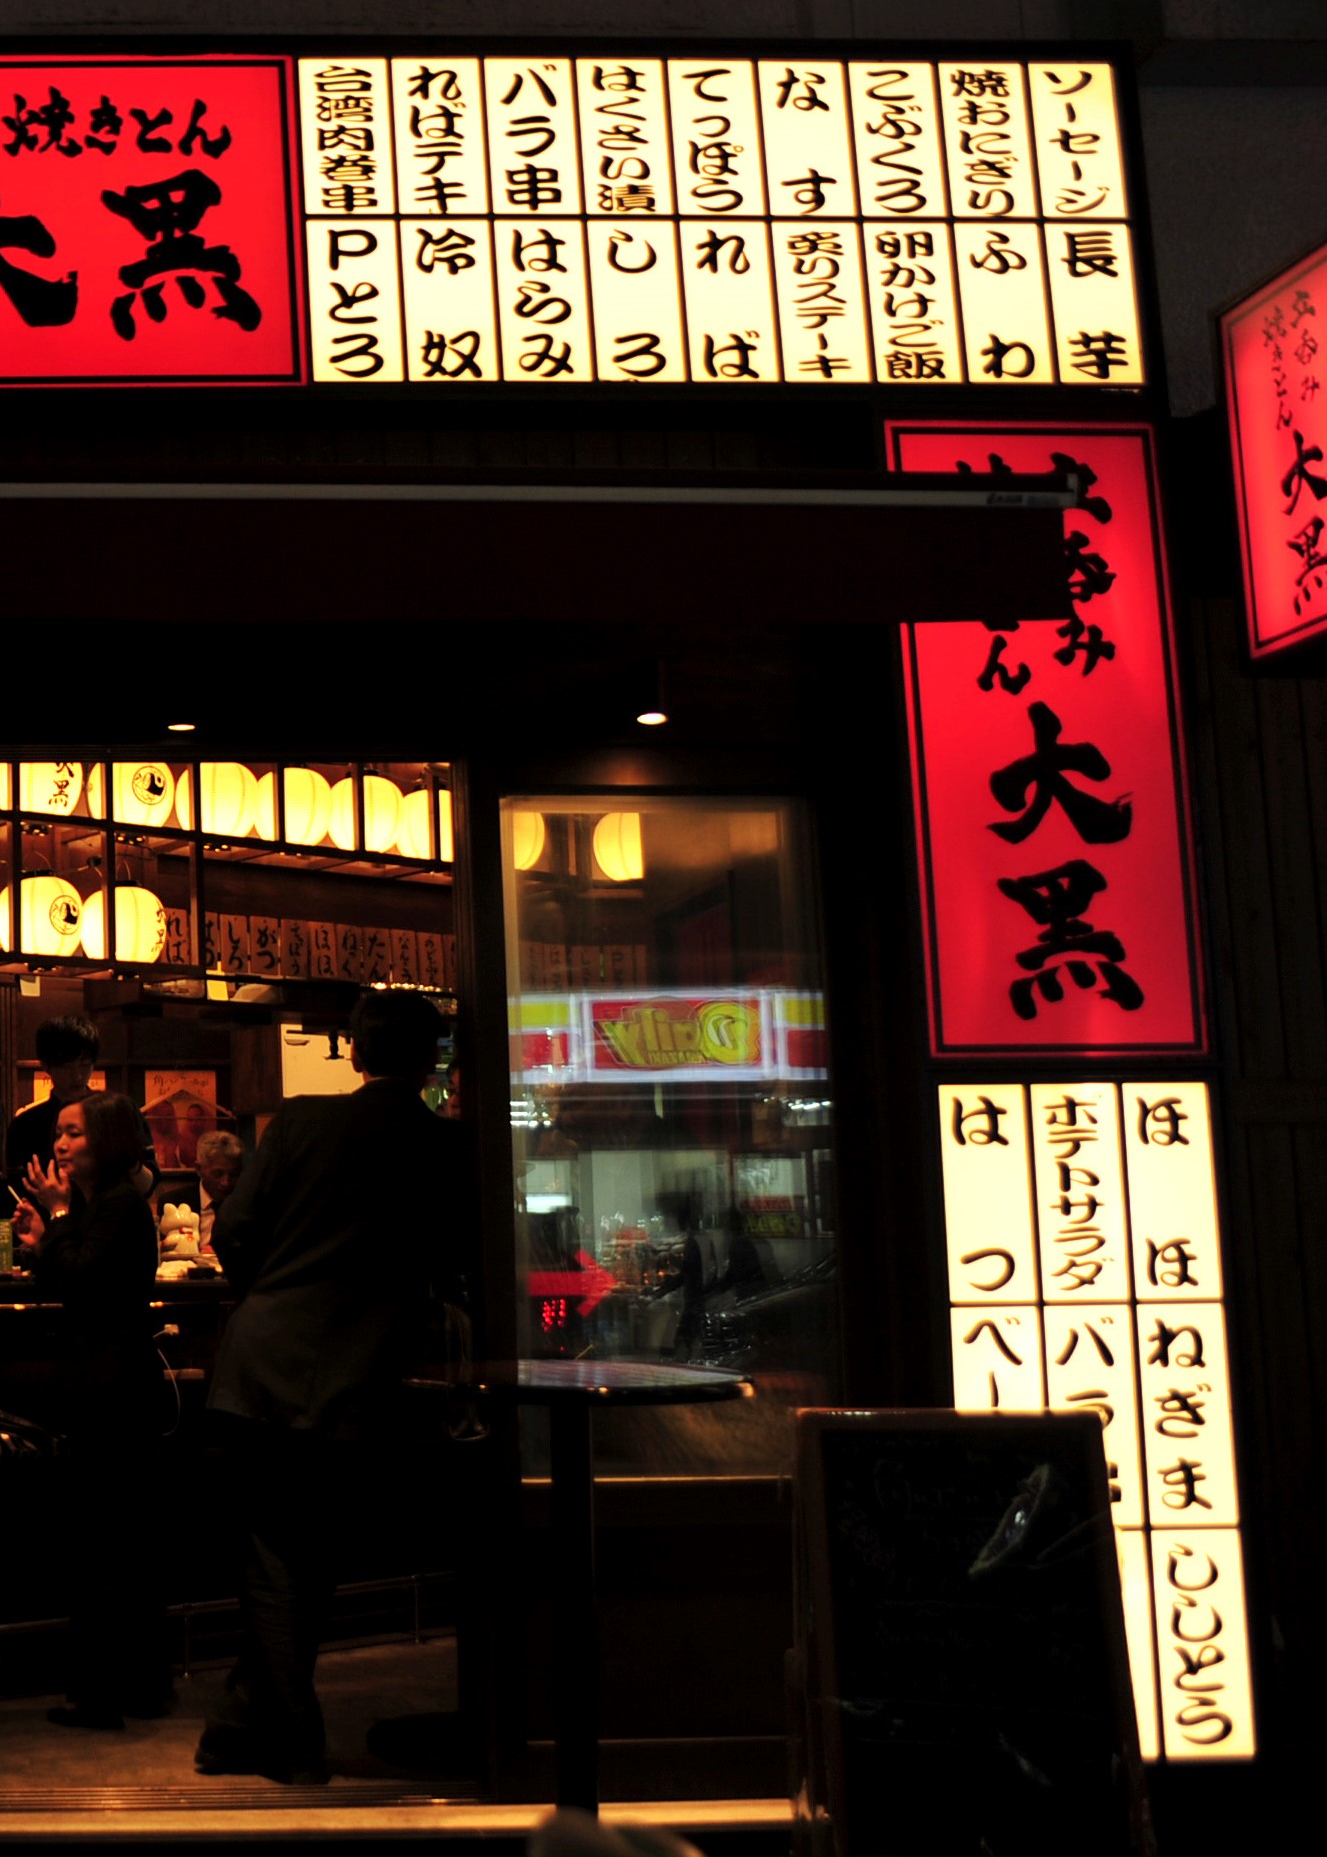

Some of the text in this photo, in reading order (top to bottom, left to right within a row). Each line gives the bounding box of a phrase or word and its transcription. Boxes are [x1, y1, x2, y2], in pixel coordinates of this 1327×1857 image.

[1, 86, 232, 160] 焼きとん
[313, 65, 378, 213] 台湾肉巻串
[407, 65, 467, 213] ればテキ
[499, 63, 562, 212] バラ串
[591, 65, 656, 213] はくさい漬
[681, 68, 745, 213] てっぽう
[775, 67, 837, 214] なす
[864, 69, 927, 214] こぶくろ
[949, 68, 1019, 216] 焼おにぎり
[1042, 70, 1110, 214] ソーセージ
[326, 228, 385, 379] Pとろ
[415, 227, 483, 379] 冷奴
[511, 228, 575, 378] はらみ
[606, 229, 667, 378] しろ
[695, 228, 761, 380] れば
[786, 230, 851, 379] 炙りステーキ
[874, 230, 947, 380] 卵かけご飯
[969, 230, 1036, 379] ふわ
[1060, 230, 1129, 380] 長芋
[985, 700, 1145, 1020] 大黒
[951, 1095, 1016, 1292] はつ
[1136, 1096, 1200, 1288] ほほ
[1147, 1318, 1213, 1510] ねぎま
[1166, 1545, 1234, 1746] ししとう
